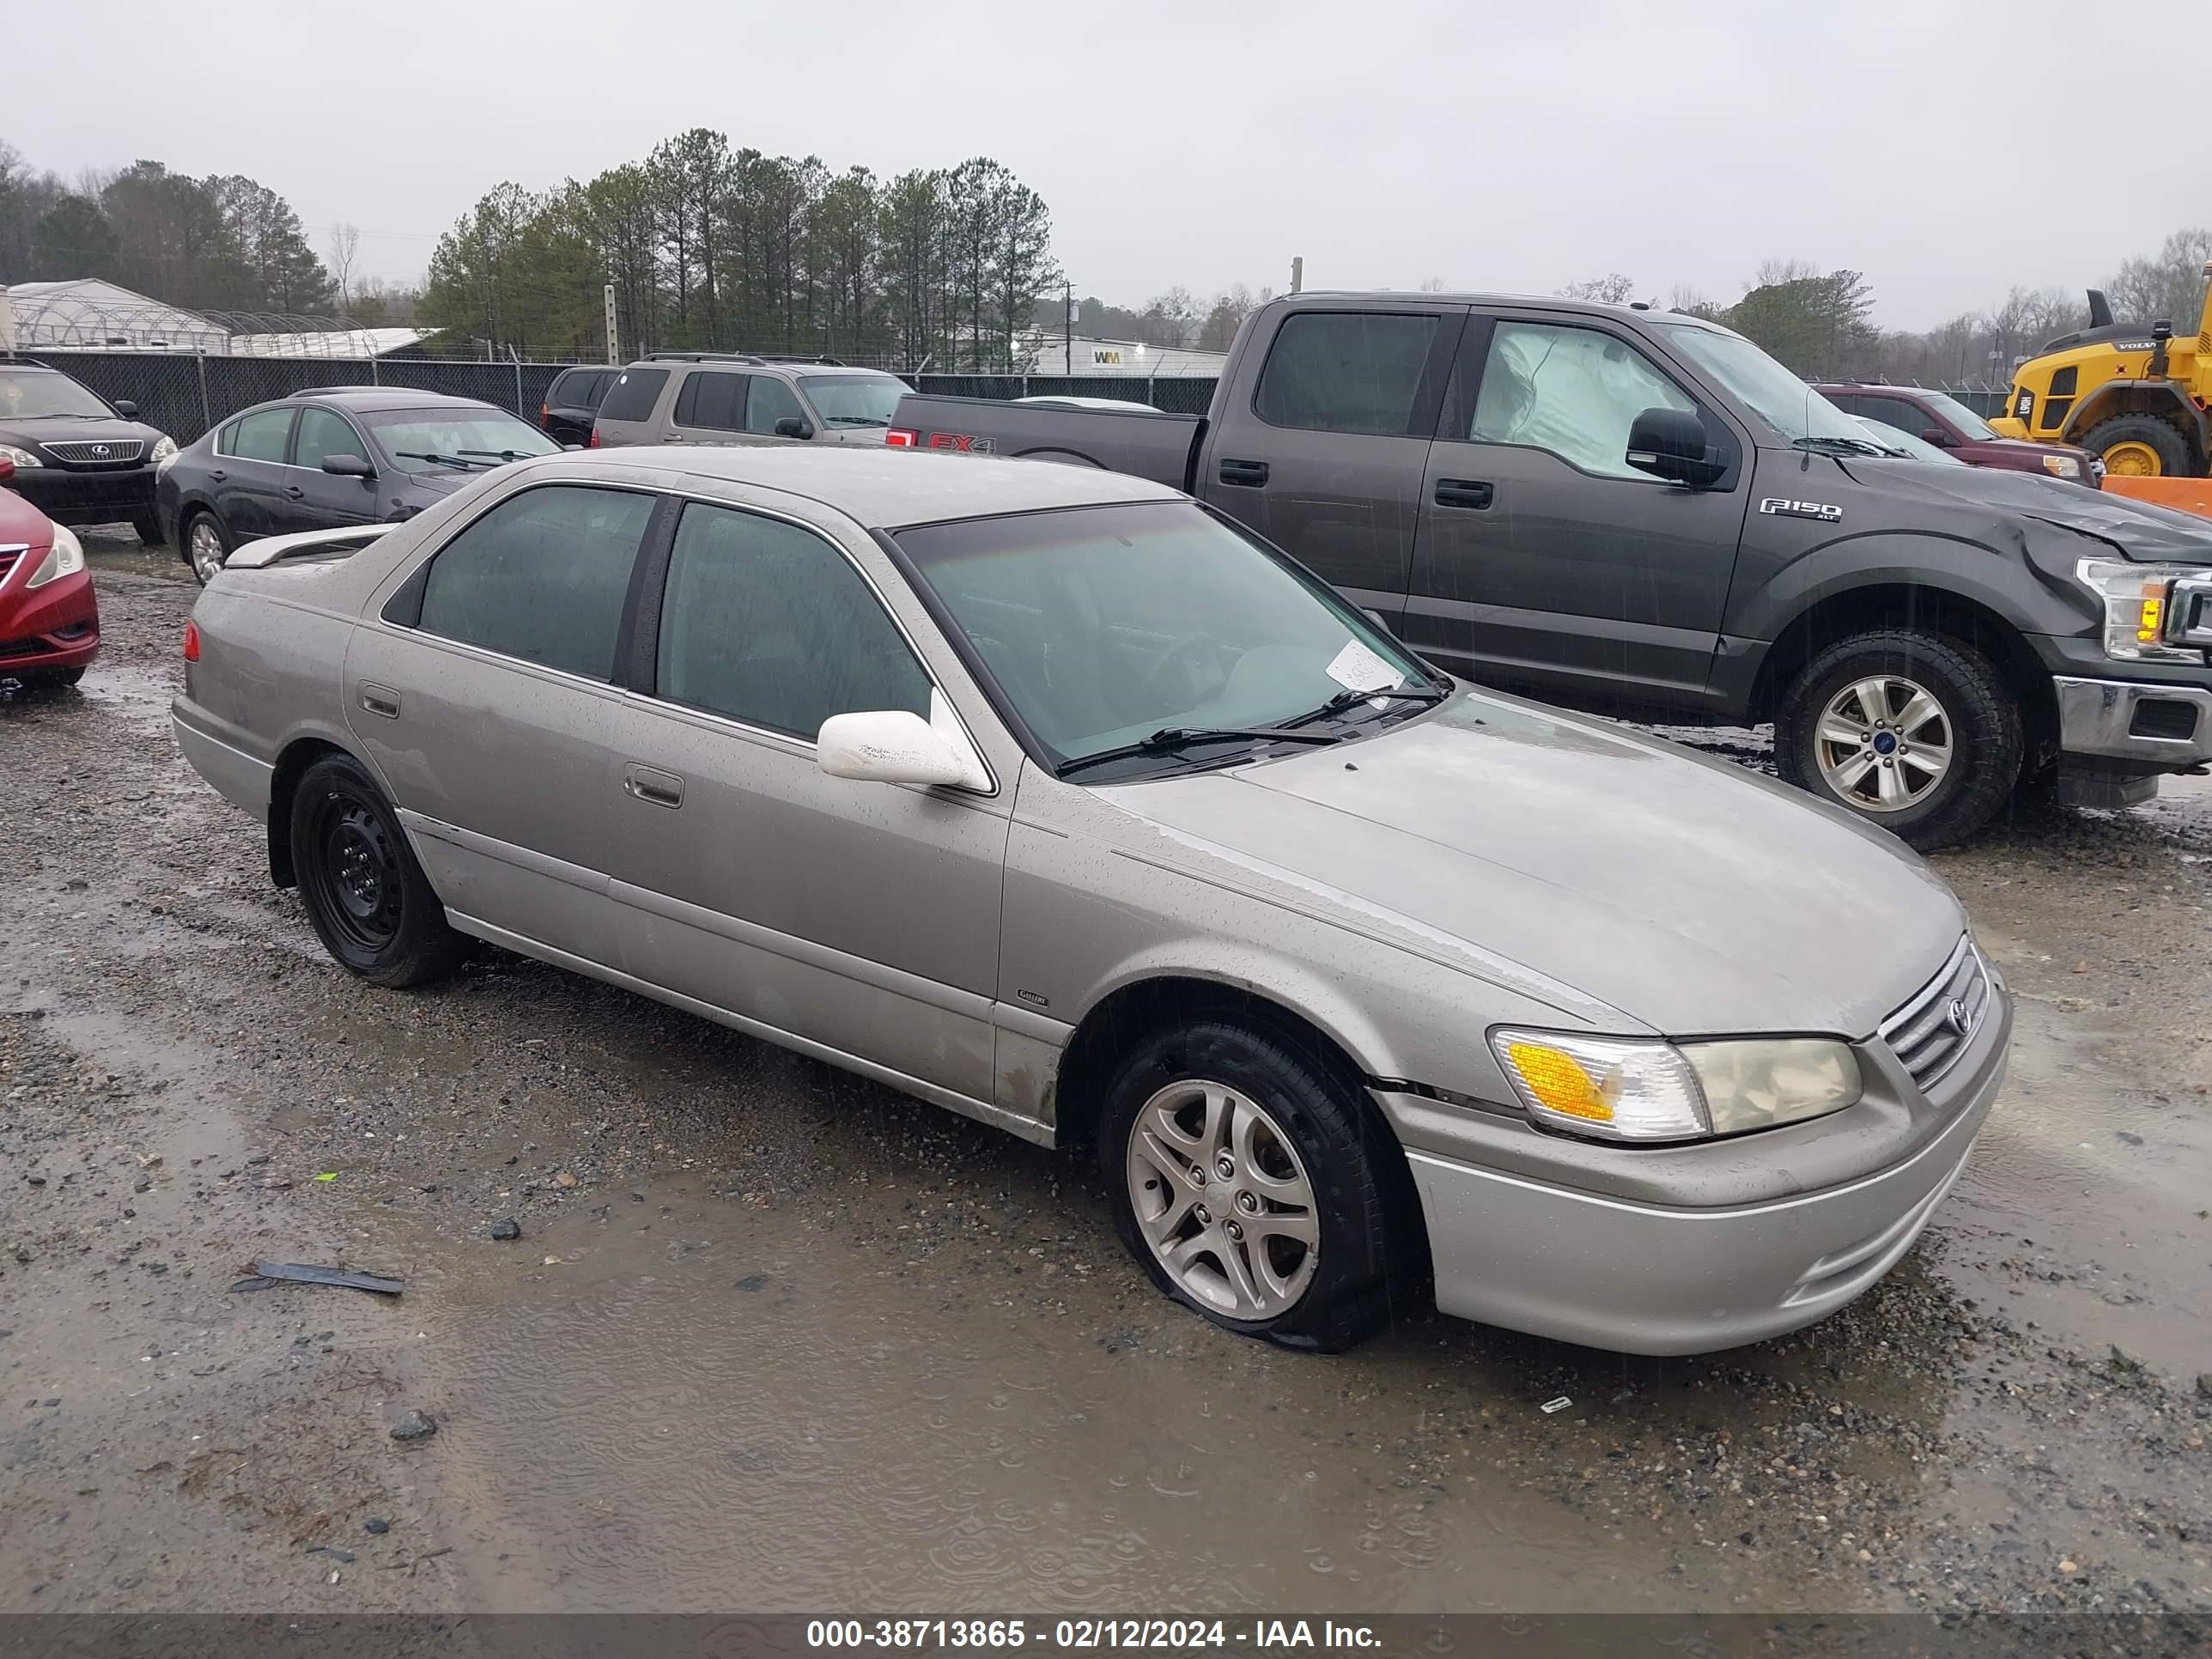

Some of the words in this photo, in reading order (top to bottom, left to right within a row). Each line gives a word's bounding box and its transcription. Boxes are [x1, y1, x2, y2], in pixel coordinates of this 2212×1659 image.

[1095, 351, 1120, 364] WM
[2020, 397, 2033, 415] L90H
[929, 432, 997, 454] FX4
